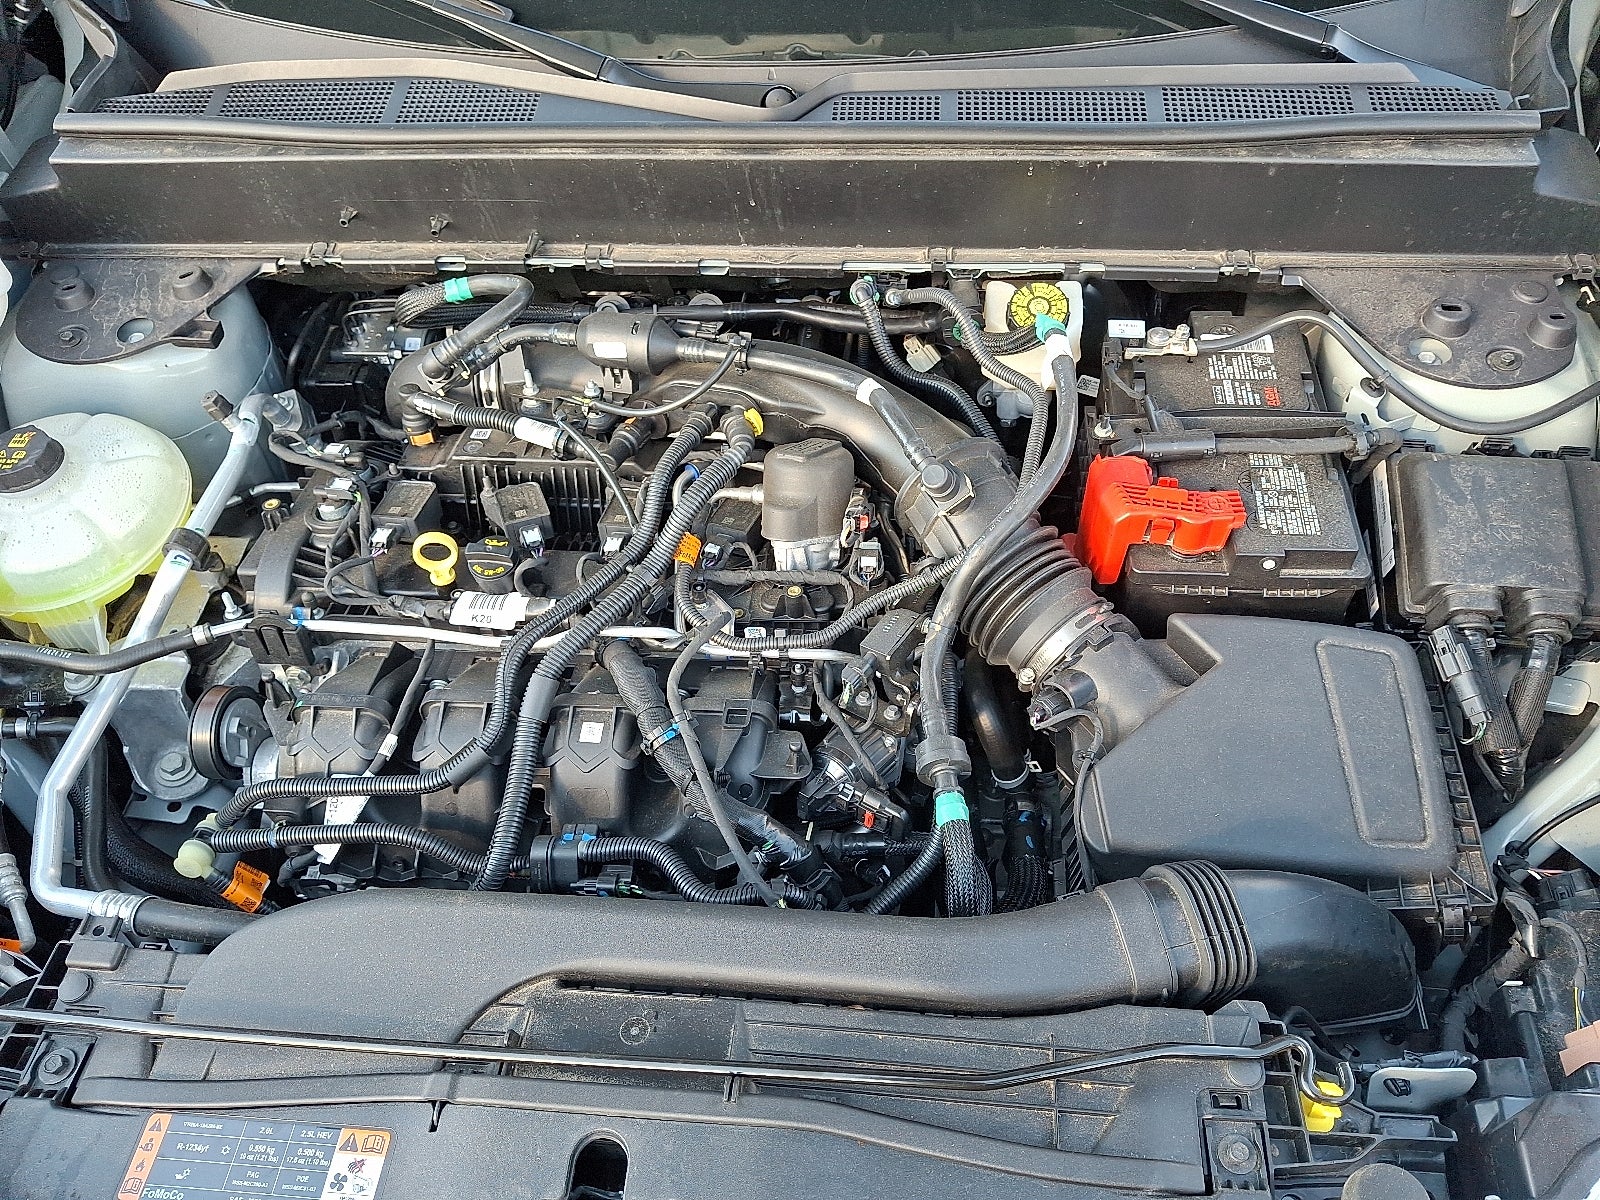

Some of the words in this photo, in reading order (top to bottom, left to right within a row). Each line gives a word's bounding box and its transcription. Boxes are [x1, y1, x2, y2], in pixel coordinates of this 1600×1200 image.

[259, 1127, 274, 1135] 2.0L
[316, 1131, 333, 1140] HEV
[176, 1142, 209, 1154] R-1234yf
[266, 1145, 275, 1155] kg
[315, 1148, 324, 1159] kg
[246, 1170, 260, 1179] PAG
[295, 1175, 310, 1183] POE
[141, 1188, 185, 1200] FoMoCo
